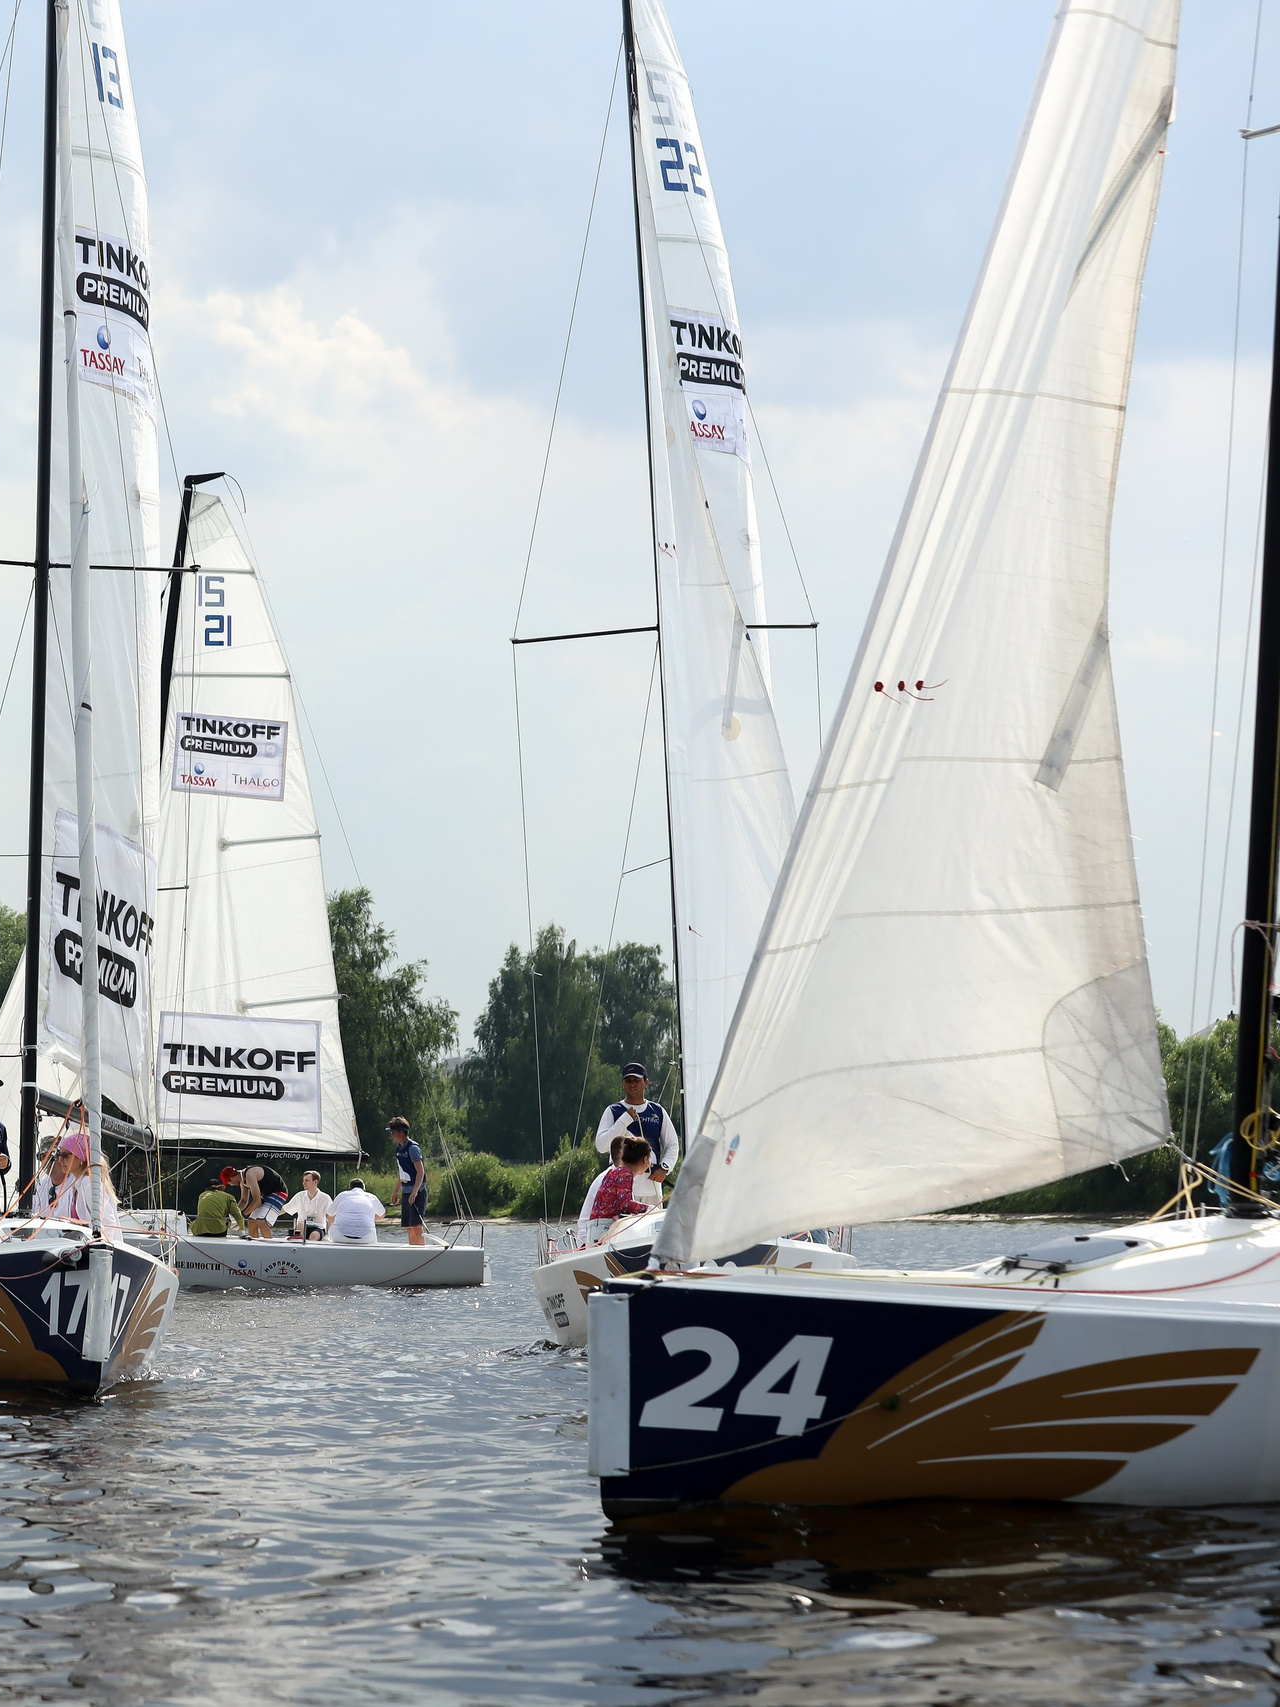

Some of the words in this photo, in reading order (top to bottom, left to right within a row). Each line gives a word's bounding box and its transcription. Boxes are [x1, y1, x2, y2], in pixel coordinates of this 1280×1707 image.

[92, 42, 124, 110] 13
[656, 138, 706, 198] 22
[75, 235, 150, 298] TINKO
[670, 320, 743, 360] TINKO
[80, 349, 125, 376] TASSAY
[678, 357, 744, 385] PREMIU
[690, 421, 725, 440] ASSAY
[204, 614, 232, 647] 21
[181, 716, 281, 740] TINKOFF
[185, 738, 253, 755] PREMIUM
[181, 774, 218, 787] TASSAY
[232, 773, 280, 788] THALGO
[163, 1043, 316, 1072] TINKOFF
[170, 1075, 277, 1096] PREMIUM
[256, 1152, 310, 1160] pro-yachting.ru
[41, 1269, 90, 1335] 17
[639, 1326, 834, 1437] 24
